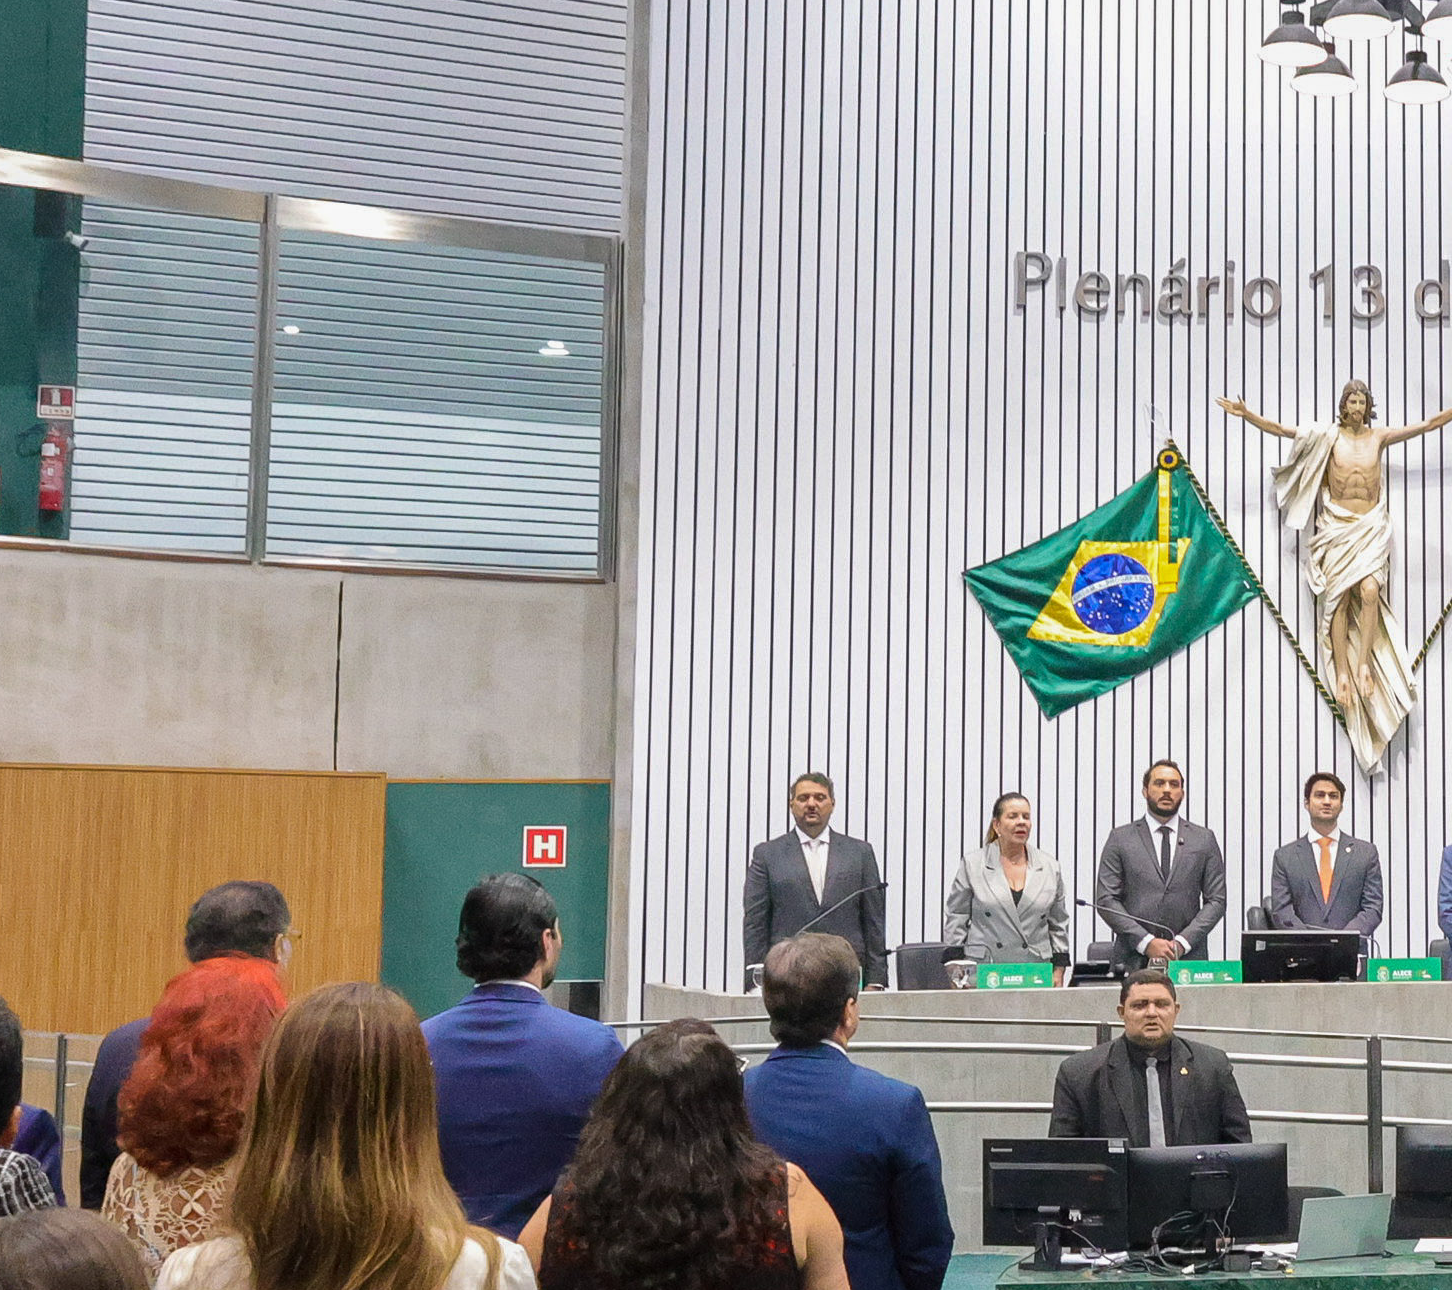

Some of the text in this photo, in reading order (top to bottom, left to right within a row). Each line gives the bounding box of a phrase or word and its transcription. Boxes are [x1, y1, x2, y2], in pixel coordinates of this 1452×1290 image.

[1013, 250, 1283, 320] Plenário
[1309, 263, 1389, 321] 13
[533, 835, 556, 859] H
